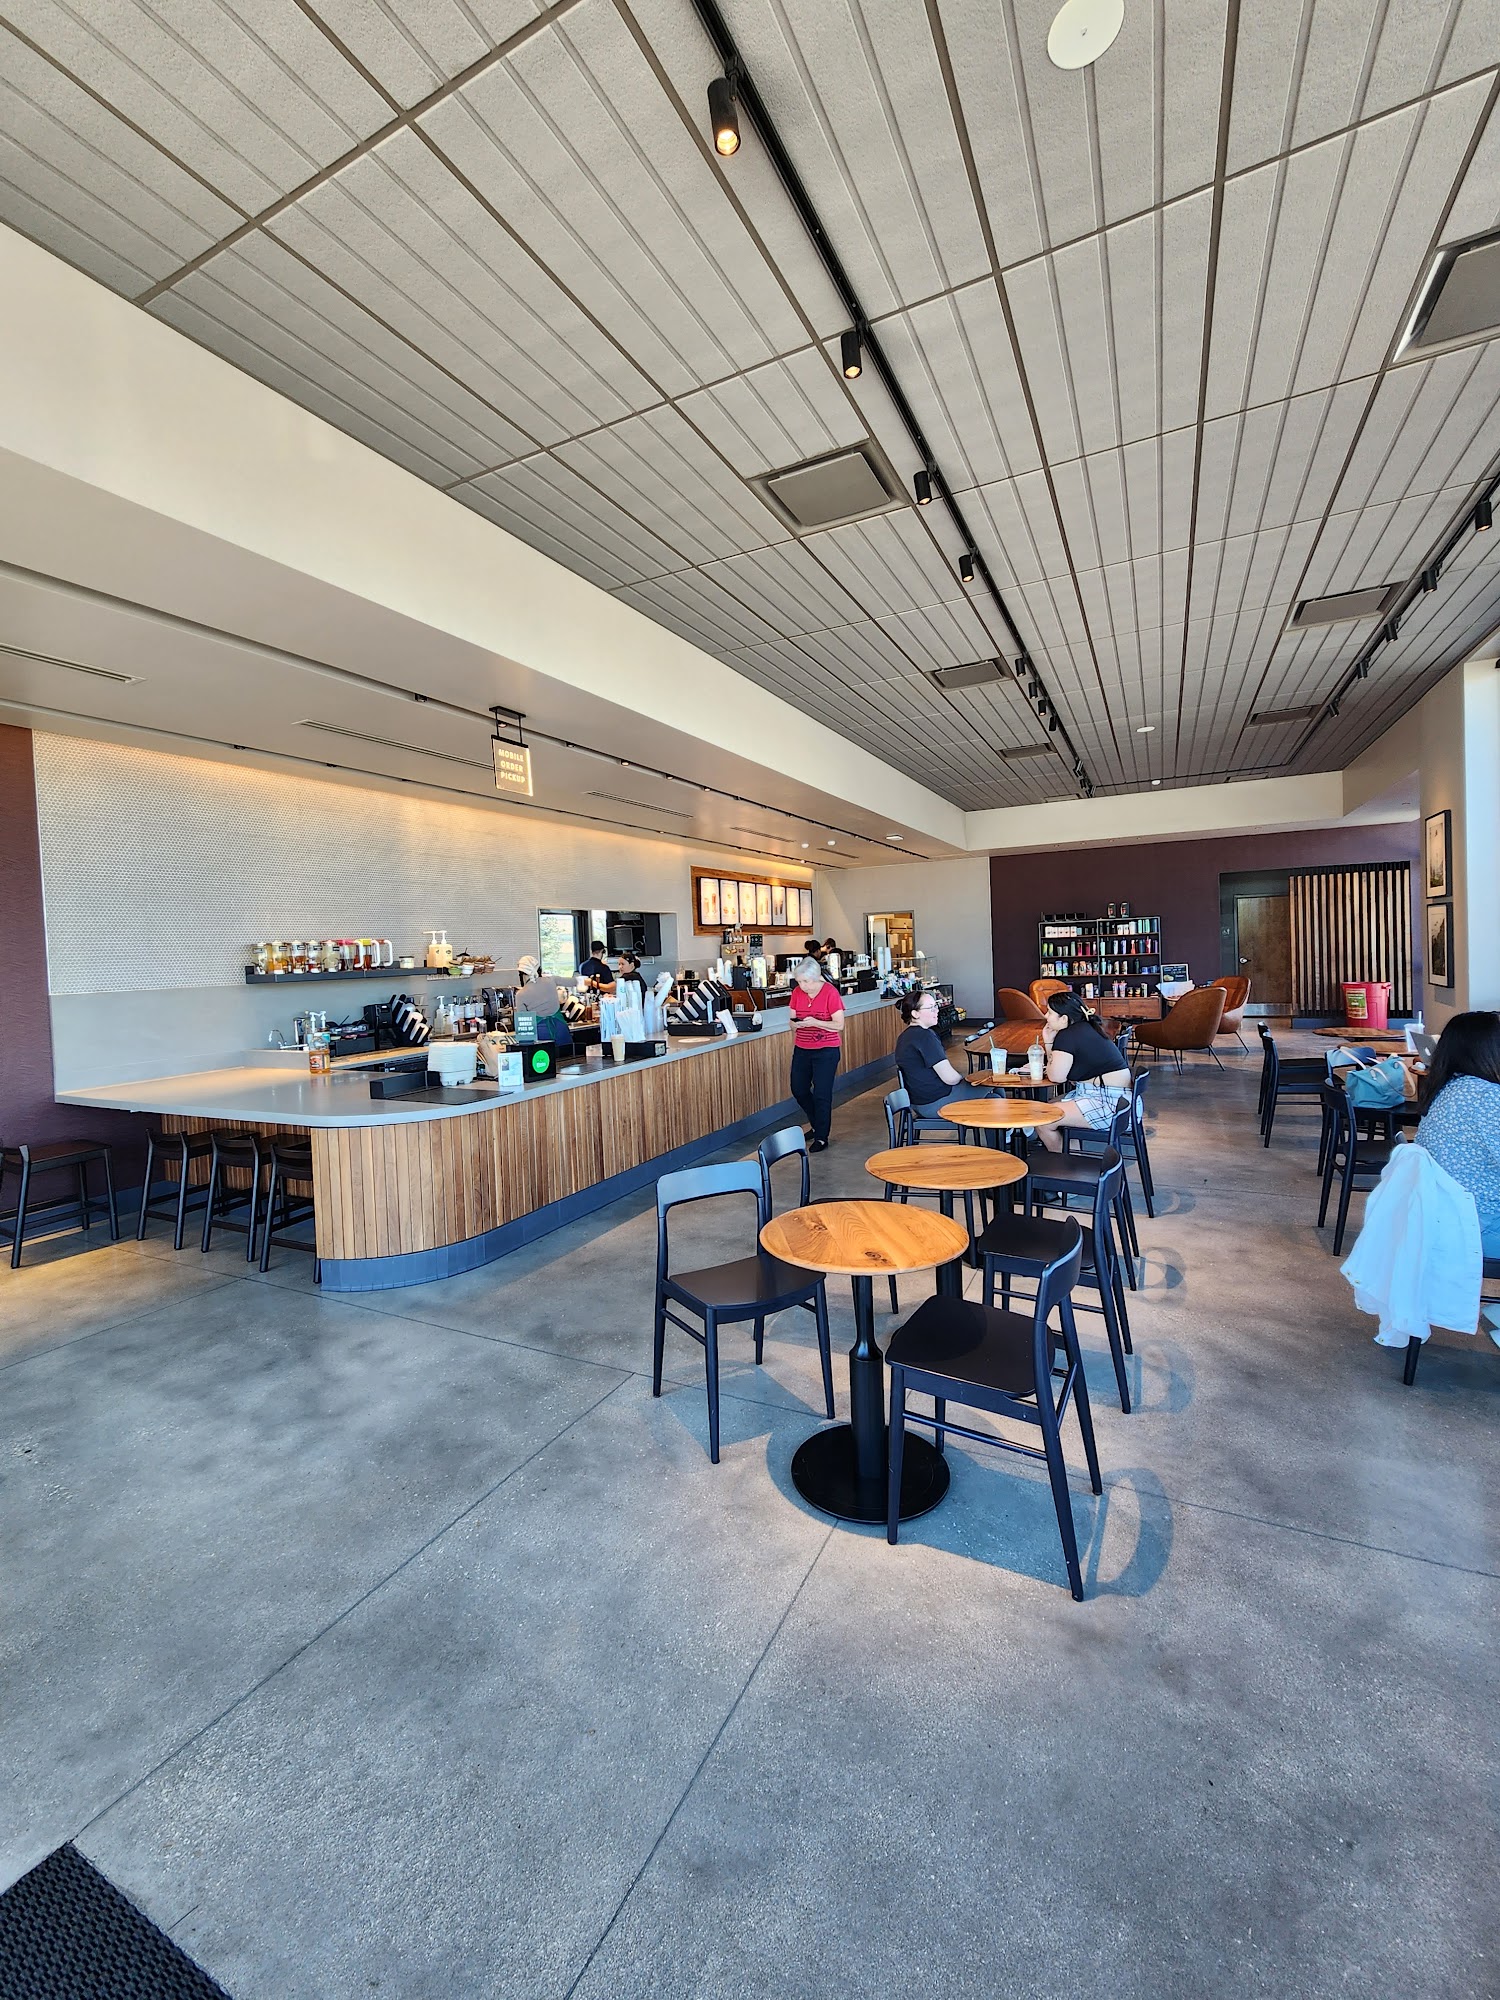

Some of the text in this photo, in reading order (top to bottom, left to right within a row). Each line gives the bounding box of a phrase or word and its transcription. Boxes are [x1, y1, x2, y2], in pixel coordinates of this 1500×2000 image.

[498, 748, 524, 762] MOBILE
[500, 760, 524, 773] ORDER
[500, 771, 526, 783] PICKUP
